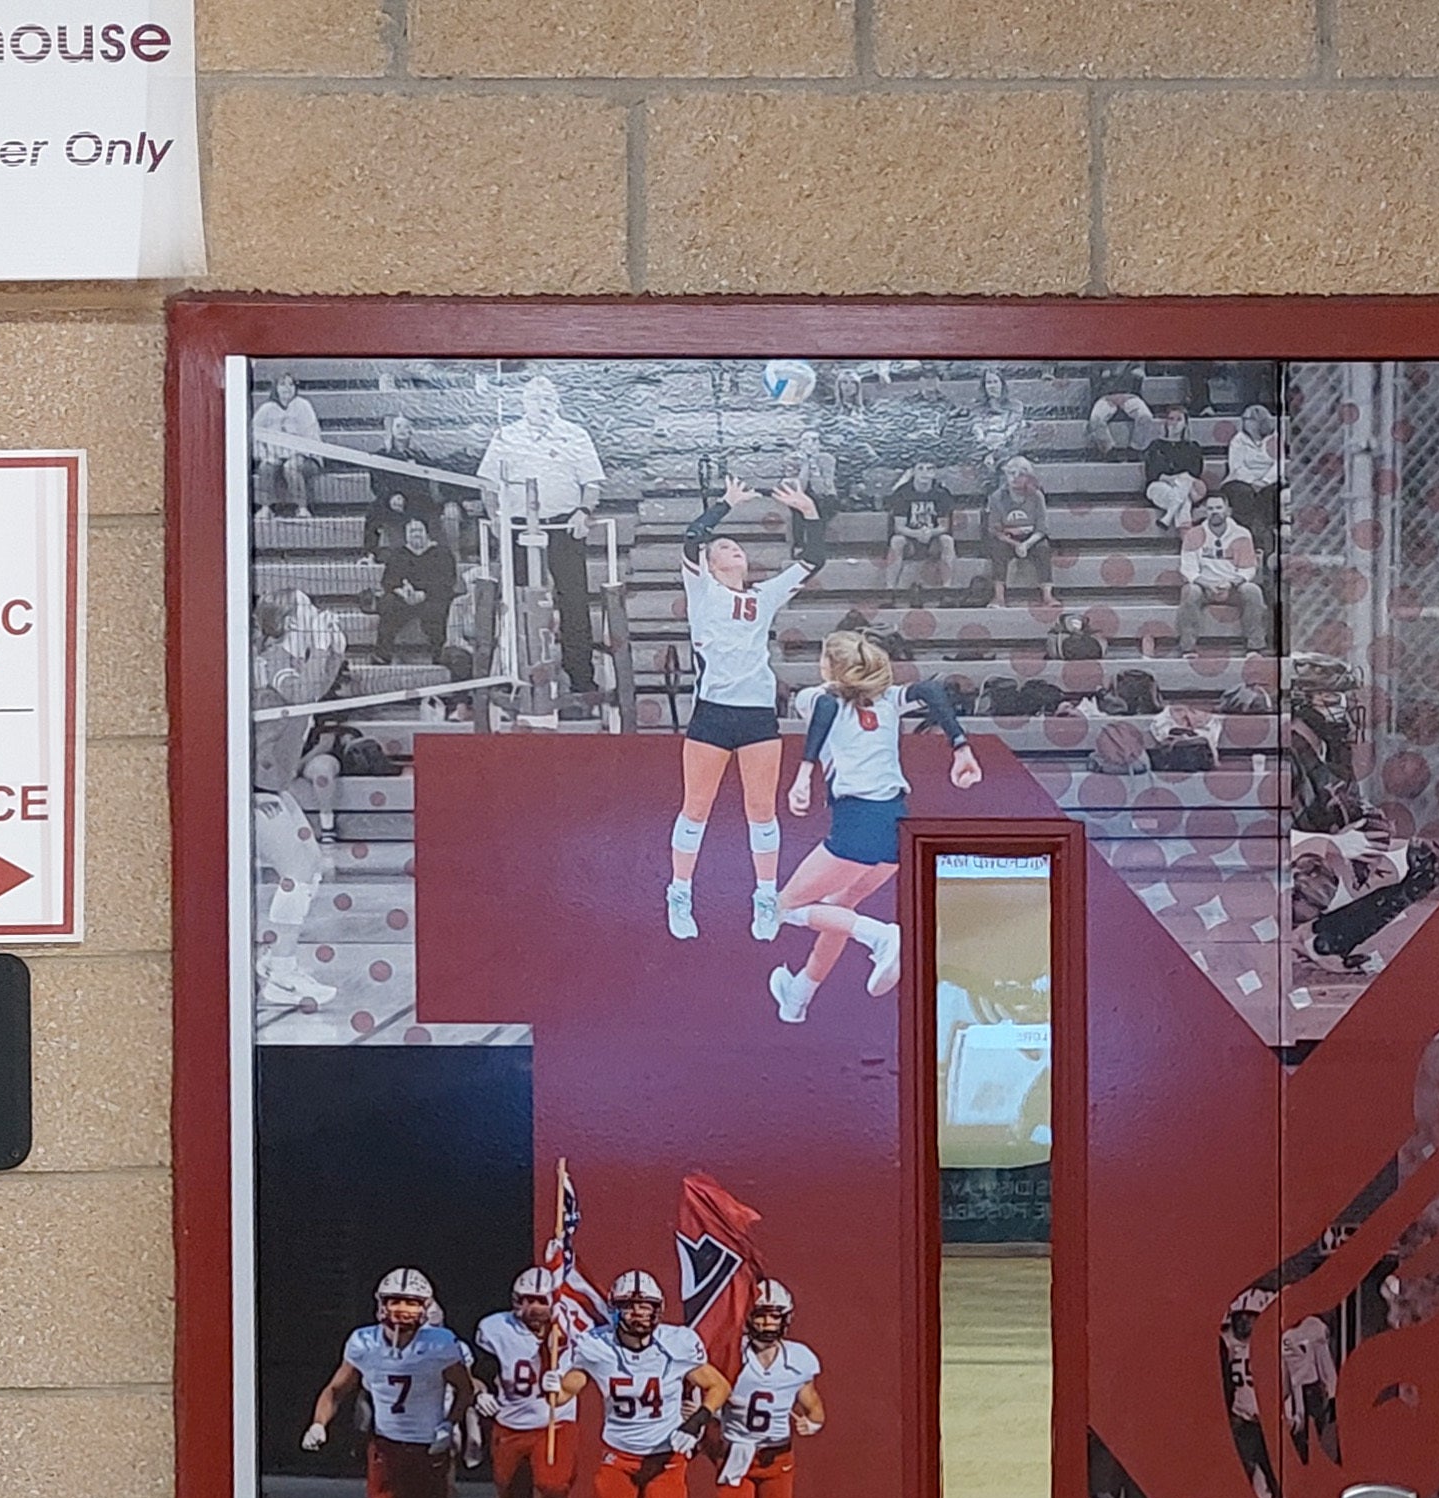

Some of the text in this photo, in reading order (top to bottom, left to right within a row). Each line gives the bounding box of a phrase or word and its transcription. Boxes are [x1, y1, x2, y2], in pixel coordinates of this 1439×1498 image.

[64, 130, 174, 173] Only
[732, 595, 758, 622] 15
[388, 1375, 412, 1414] 7
[609, 1377, 664, 1419] 54
[745, 1390, 774, 1432] 6
